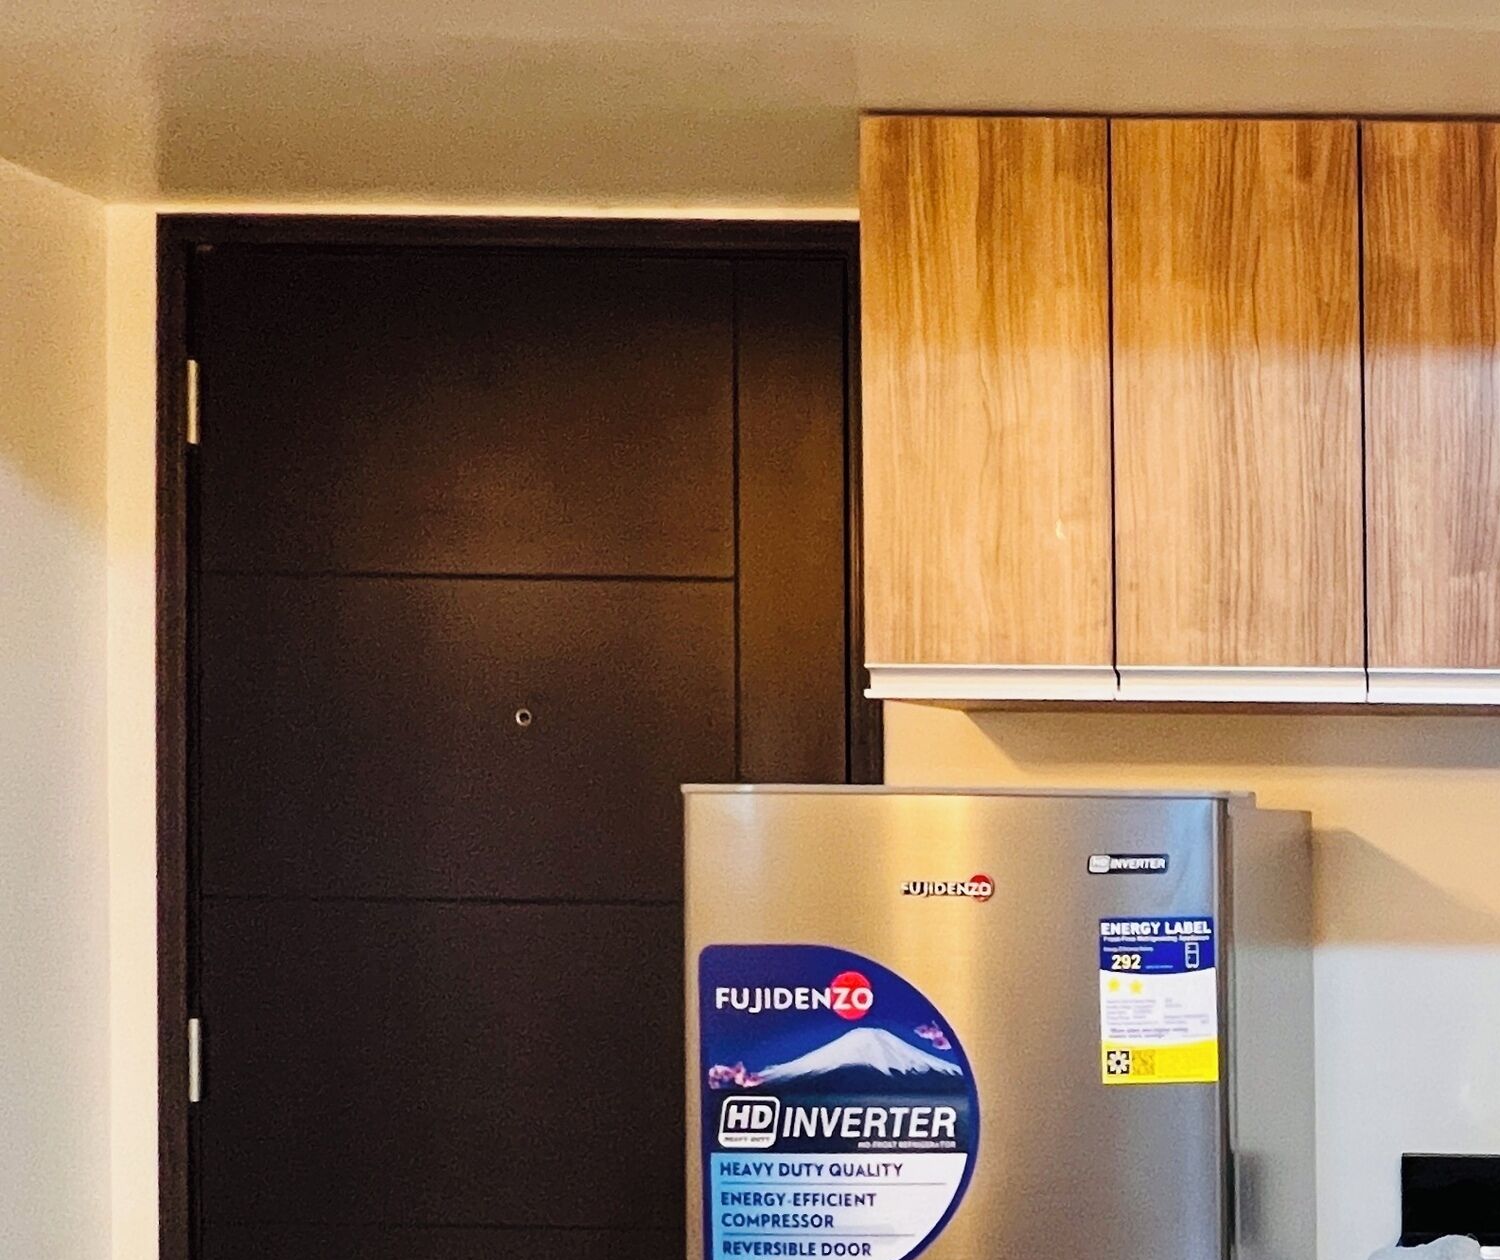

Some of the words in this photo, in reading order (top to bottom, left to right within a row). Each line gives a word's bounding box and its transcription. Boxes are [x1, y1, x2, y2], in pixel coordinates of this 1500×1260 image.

[1110, 858, 1166, 869] INVERTER
[901, 881, 993, 897] FUJIDENZO
[1101, 921, 1161, 936] ENERGY
[1164, 920, 1212, 935] LABEL
[1111, 954, 1142, 970] 292
[715, 986, 874, 1013] FUJIDENZO
[728, 1104, 773, 1129] HD
[782, 1107, 957, 1138] INVERTER
[720, 1162, 774, 1176] HEAVY
[779, 1163, 824, 1176] DUTY
[829, 1163, 903, 1178] QUALITY
[721, 1192, 877, 1208] ENERGY-EFFICIENT
[721, 1213, 834, 1229] COMPRESSOR
[722, 1240, 817, 1256] REVERSIBLE
[821, 1242, 871, 1256] DOOR
